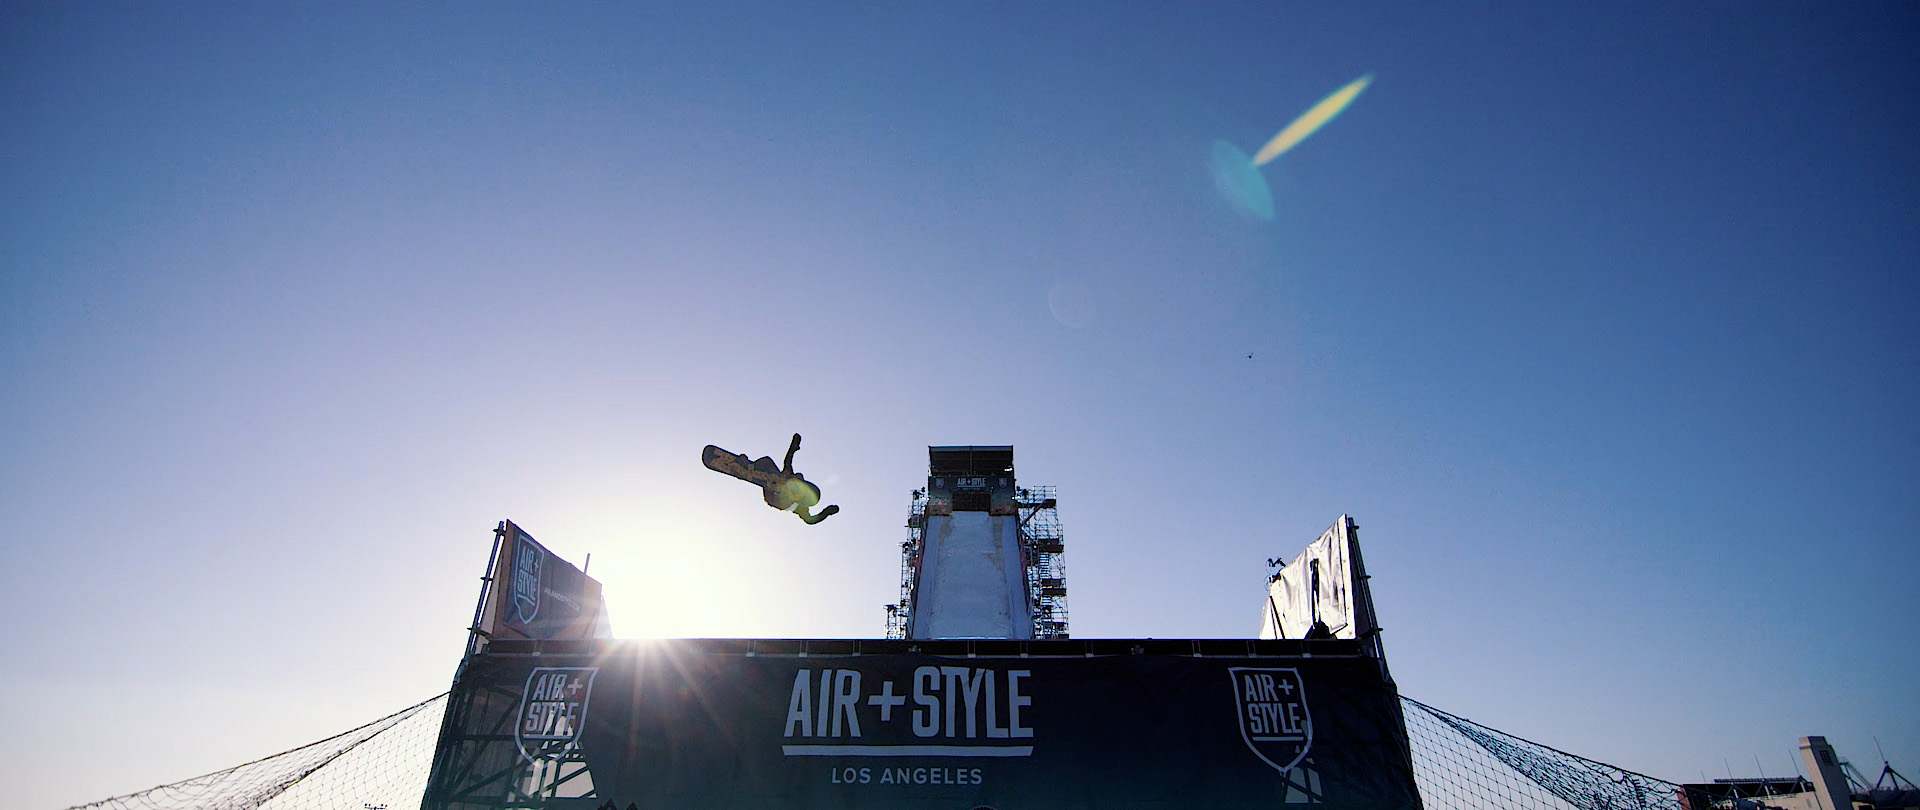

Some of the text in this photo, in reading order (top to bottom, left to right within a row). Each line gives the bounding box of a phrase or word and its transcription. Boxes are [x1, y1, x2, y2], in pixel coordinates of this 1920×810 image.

[517, 568, 538, 601] STYLE
[912, 665, 1034, 739] STYLE
[1244, 673, 1279, 702] AIR
[1248, 702, 1303, 734] STYLE
[831, 767, 983, 785] LOS ANGELES
